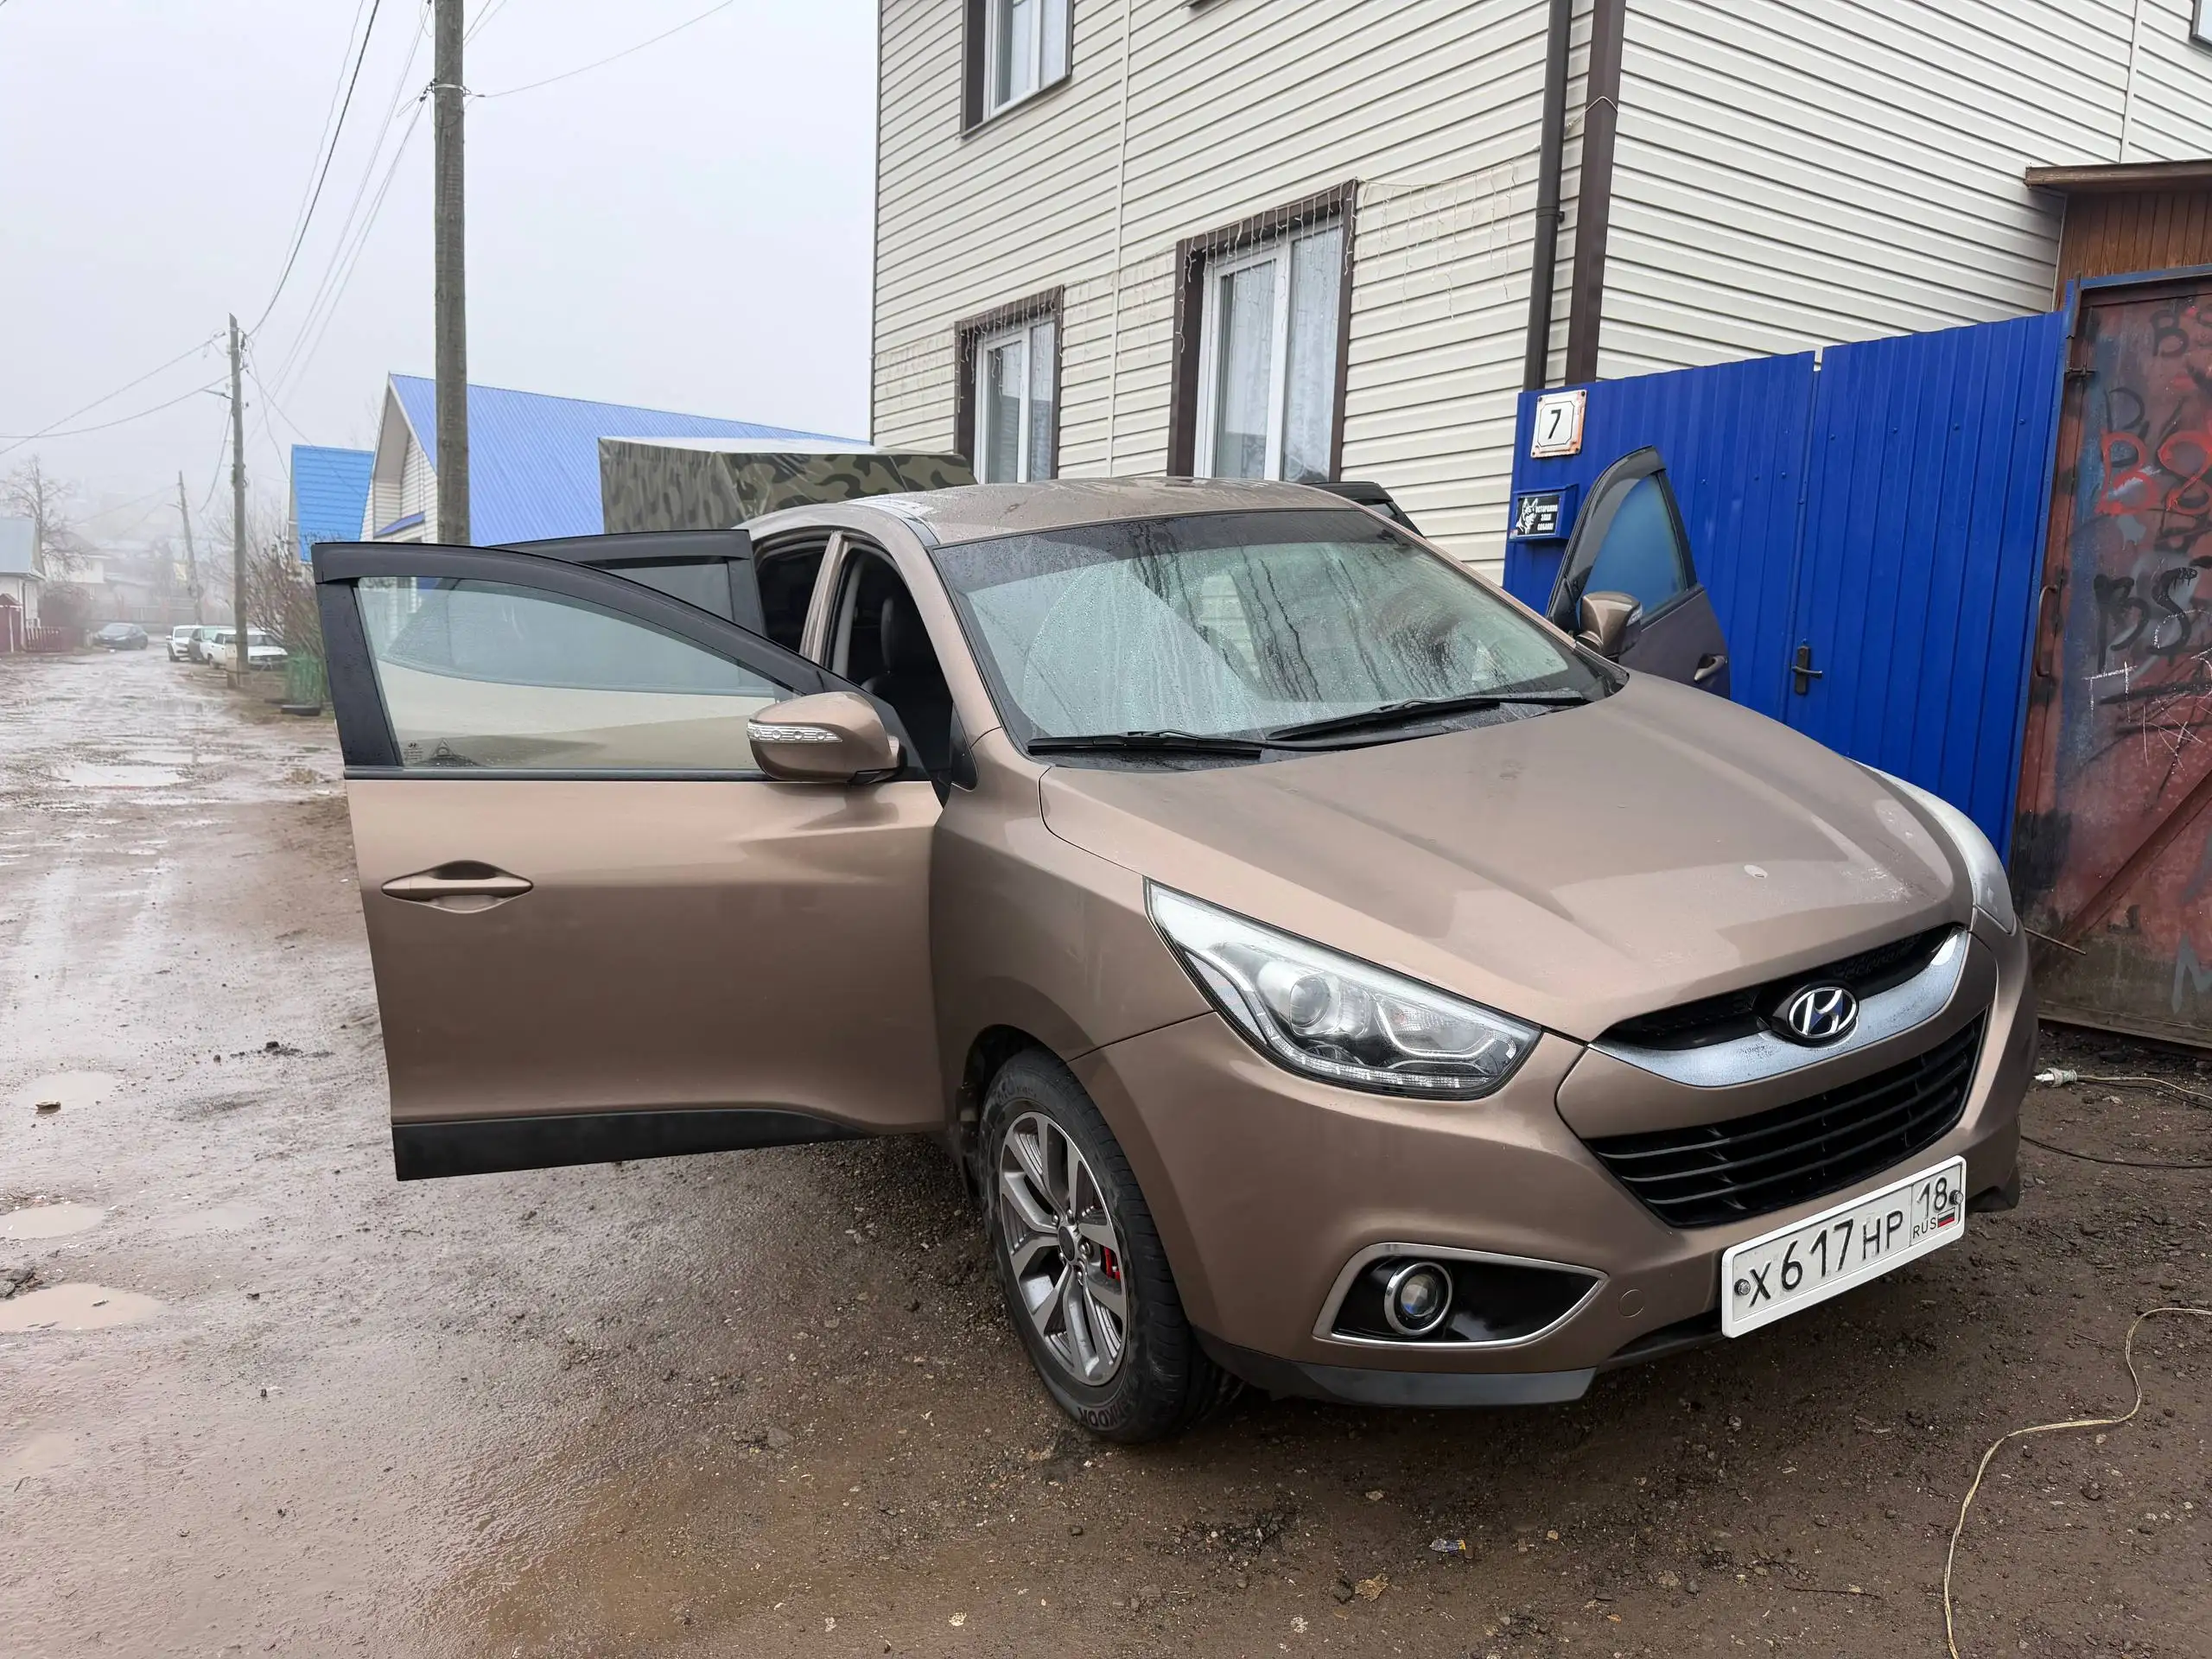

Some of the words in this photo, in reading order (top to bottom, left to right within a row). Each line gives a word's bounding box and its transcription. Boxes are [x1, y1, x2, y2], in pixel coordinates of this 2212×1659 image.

[1548, 409, 1562, 440] 7
[1916, 1176, 1948, 1219] 18
[1912, 1216, 1937, 1239] RUS
